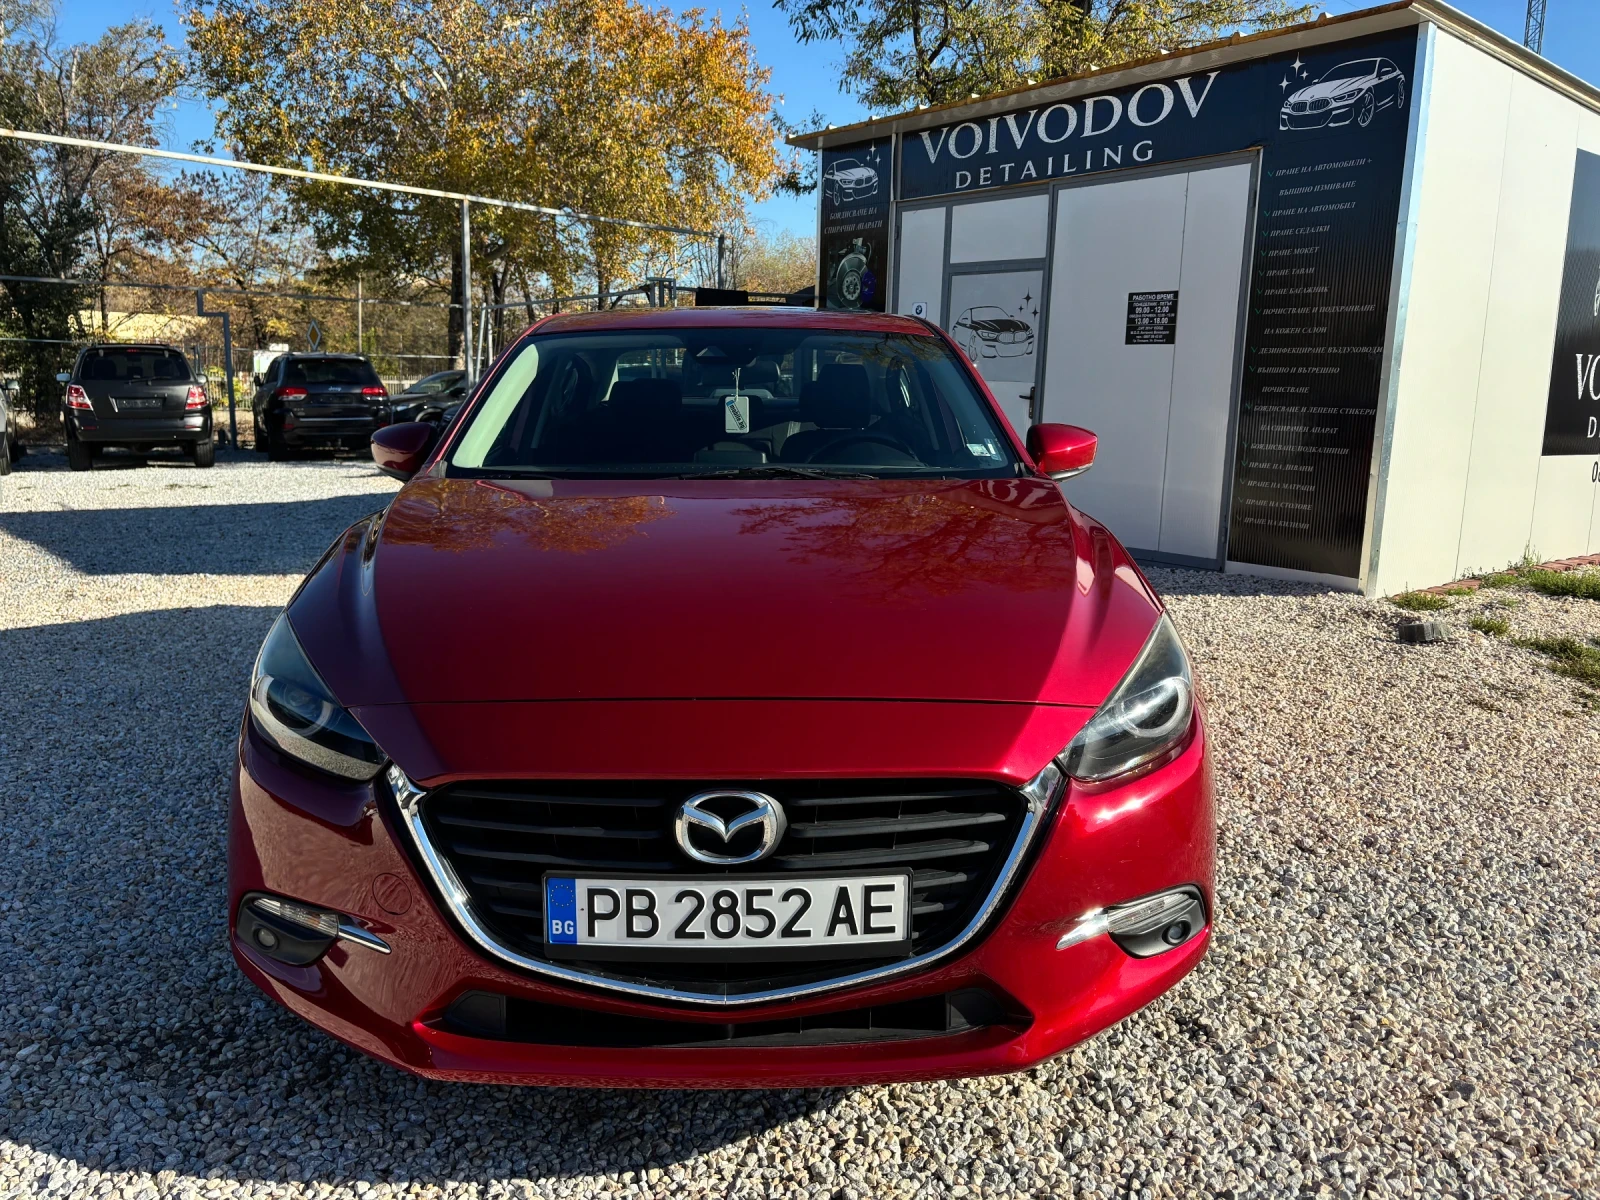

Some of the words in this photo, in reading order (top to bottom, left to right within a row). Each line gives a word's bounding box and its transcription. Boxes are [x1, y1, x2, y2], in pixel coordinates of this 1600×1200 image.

[920, 71, 1221, 164] VOIVODOV
[955, 140, 1153, 189] DETAILING
[1275, 167, 1300, 176] ПРАНЕ
[1312, 158, 1366, 172] АВТОМОБИЛИ
[1279, 186, 1313, 196] ВЪНШНО
[1314, 180, 1356, 192] ИЗМИВАНЕ
[868, 206, 878, 215] НА
[1272, 207, 1296, 217] ПРАНЕ
[1309, 202, 1356, 213] АВТОМОБИЛ
[1270, 228, 1294, 237] ПРАНЕ
[1295, 225, 1330, 235] СЕДАЛКИ
[1268, 248, 1292, 257] ПРАНЕ
[1293, 246, 1320, 256] МОКЕТ
[1266, 268, 1290, 277] ПРАНЕ
[1291, 267, 1315, 275] ТАВАН
[1264, 288, 1288, 296] ПРАНЕ
[1289, 286, 1329, 295] БАГАЖНИК
[1263, 306, 1311, 315] ПОЧИСТВАНЕ
[1302, 326, 1327, 334] САЛОН
[1257, 366, 1290, 374] ВЪНШНО
[1297, 366, 1340, 374] ВЪТРЕШНО
[1262, 386, 1310, 394] ПОЧИСТВАНЕ
[1340, 408, 1376, 416] СТИКЕРИ
[1587, 416, 1600, 439] D
[1248, 480, 1270, 488] ПРАНЕ
[1246, 498, 1268, 506] ПРАНЕ
[1244, 517, 1266, 525] ПРАНЕ
[586, 886, 660, 939] PB
[673, 887, 813, 940] 2852
[826, 883, 897, 937] AE
[551, 919, 575, 936] BG
